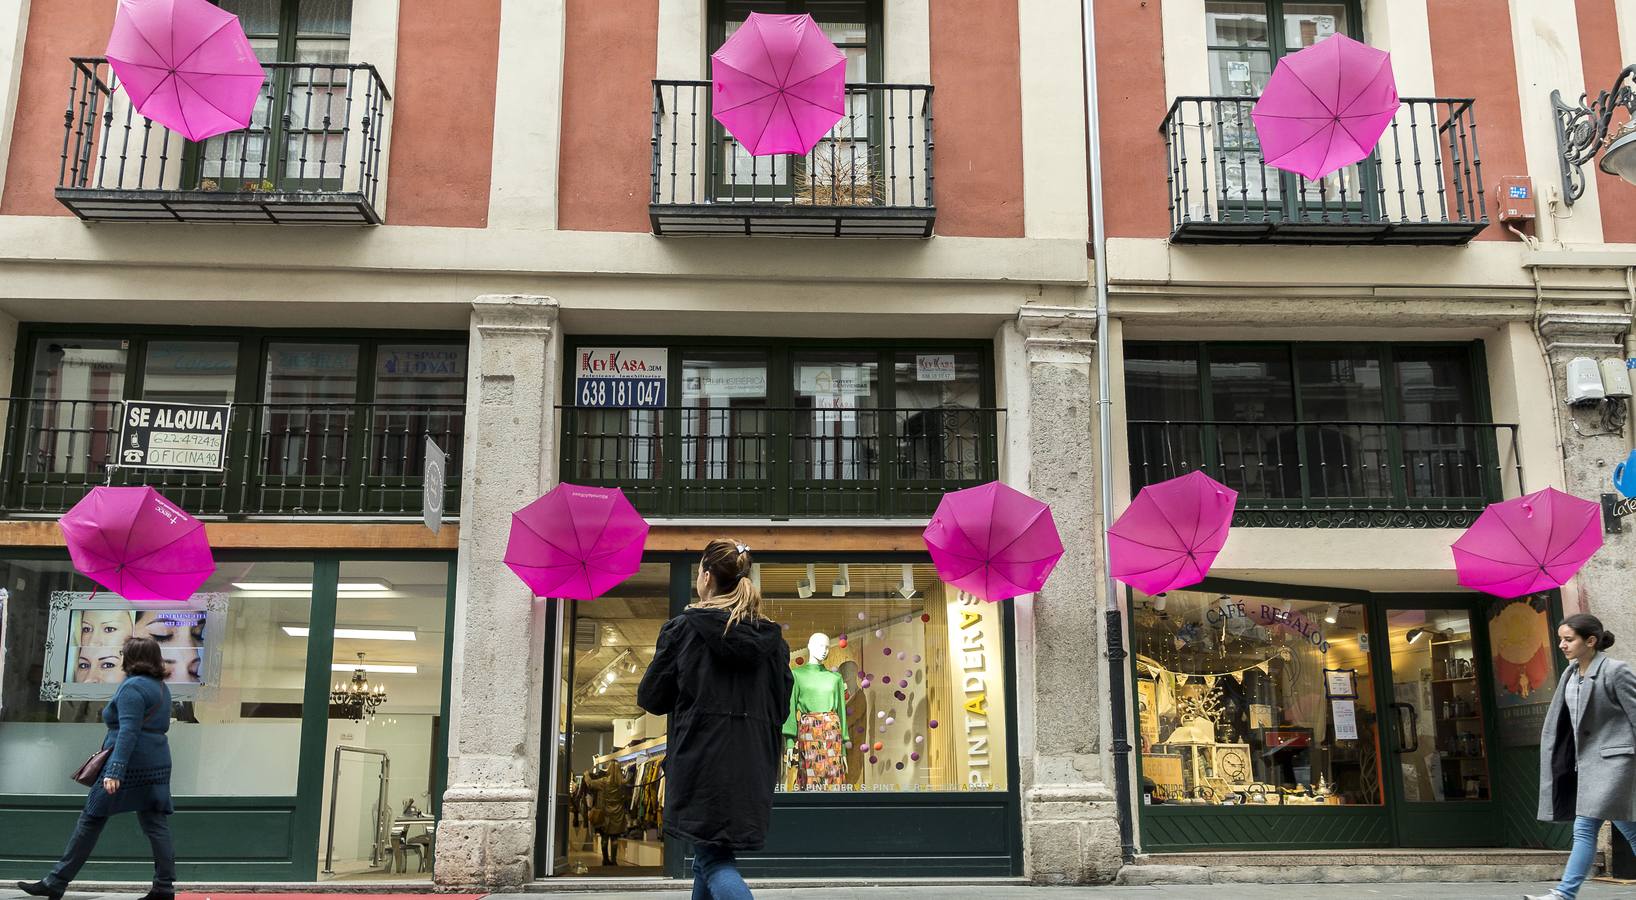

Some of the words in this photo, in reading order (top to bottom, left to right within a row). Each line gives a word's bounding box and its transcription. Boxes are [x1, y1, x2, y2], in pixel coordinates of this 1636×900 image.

[582, 380, 606, 406] 638
[611, 380, 632, 406] 181
[637, 380, 661, 406] 047
[129, 407, 151, 427] SE
[153, 408, 223, 431] ALQUILA
[149, 449, 204, 464] OFICINA
[1206, 599, 1246, 625] CAFÉ
[1260, 604, 1331, 654] REGALOS
[959, 589, 990, 788] PINTADERAS
